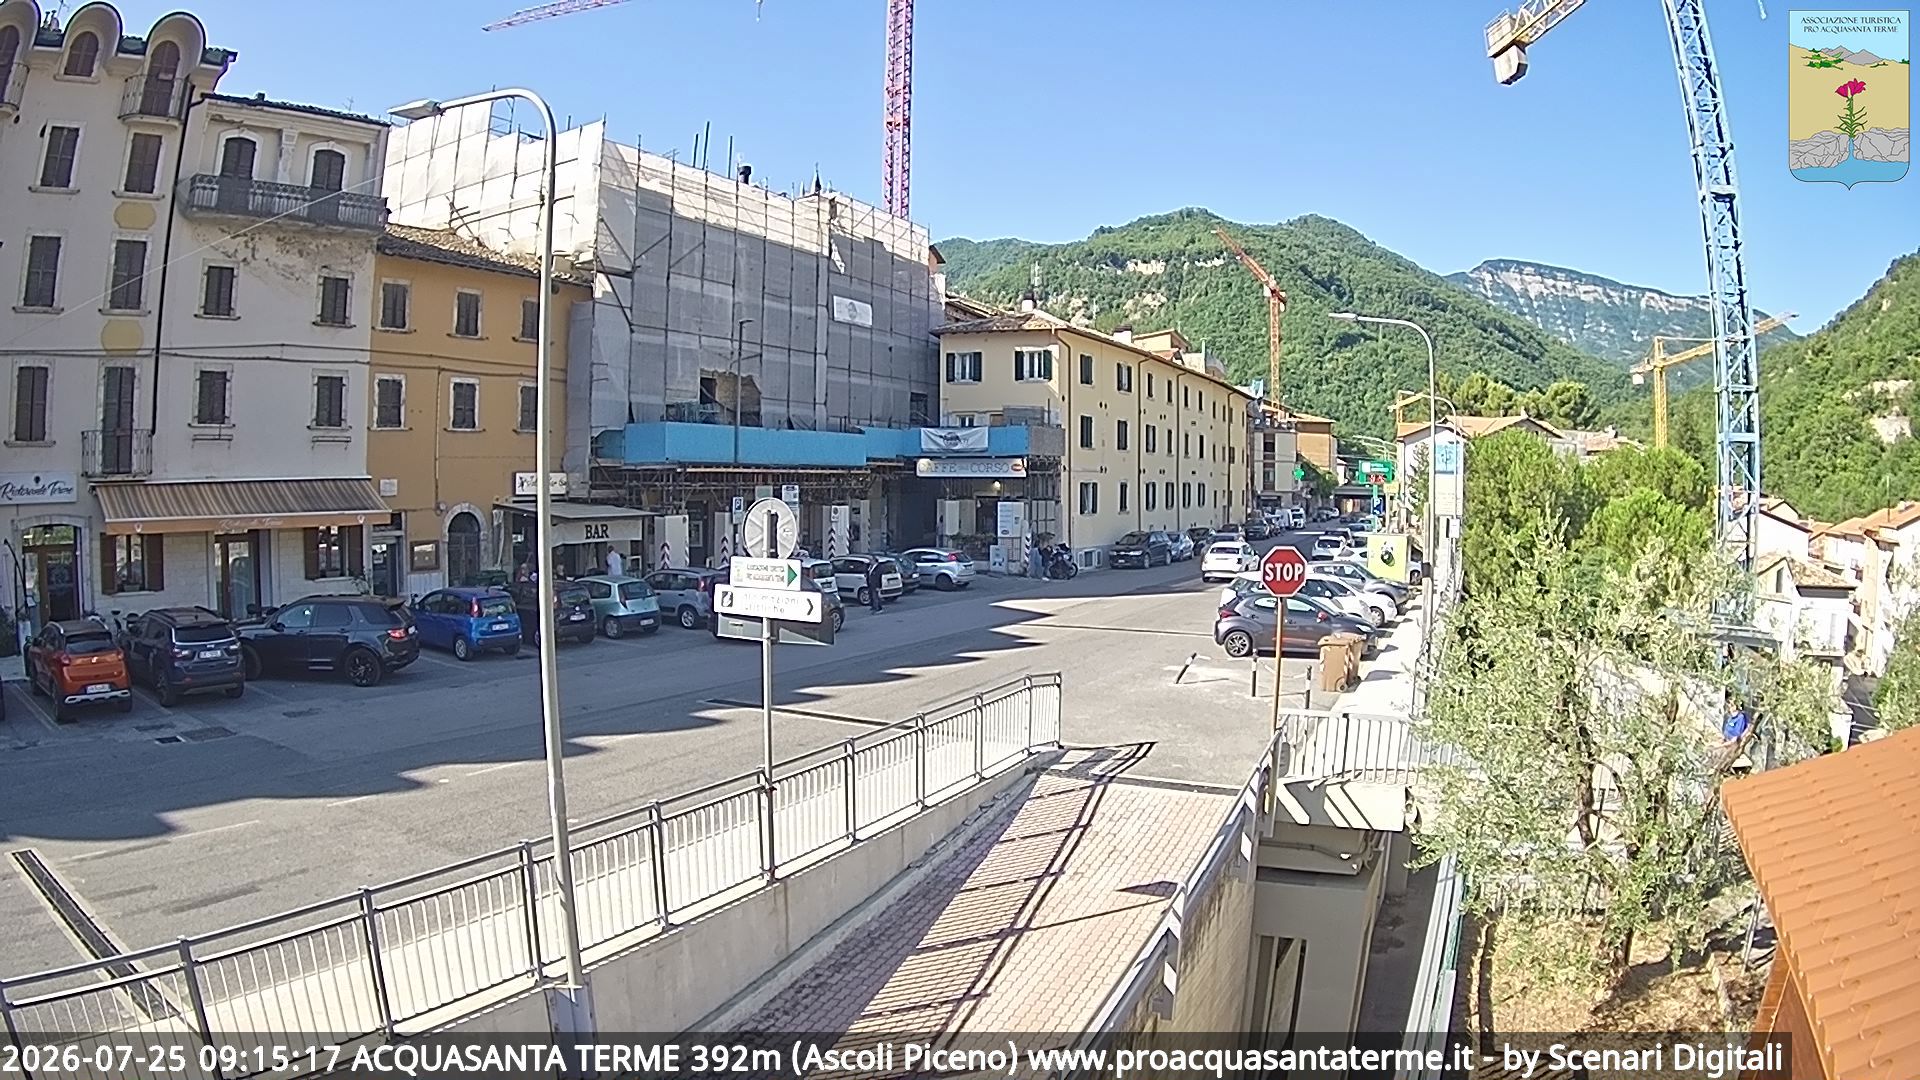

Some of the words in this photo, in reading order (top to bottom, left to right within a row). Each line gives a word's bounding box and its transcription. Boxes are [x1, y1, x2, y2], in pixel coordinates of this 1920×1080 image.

[970, 463, 1010, 473] CORSO
[585, 524, 610, 540] BAR
[1265, 562, 1303, 582] STOP
